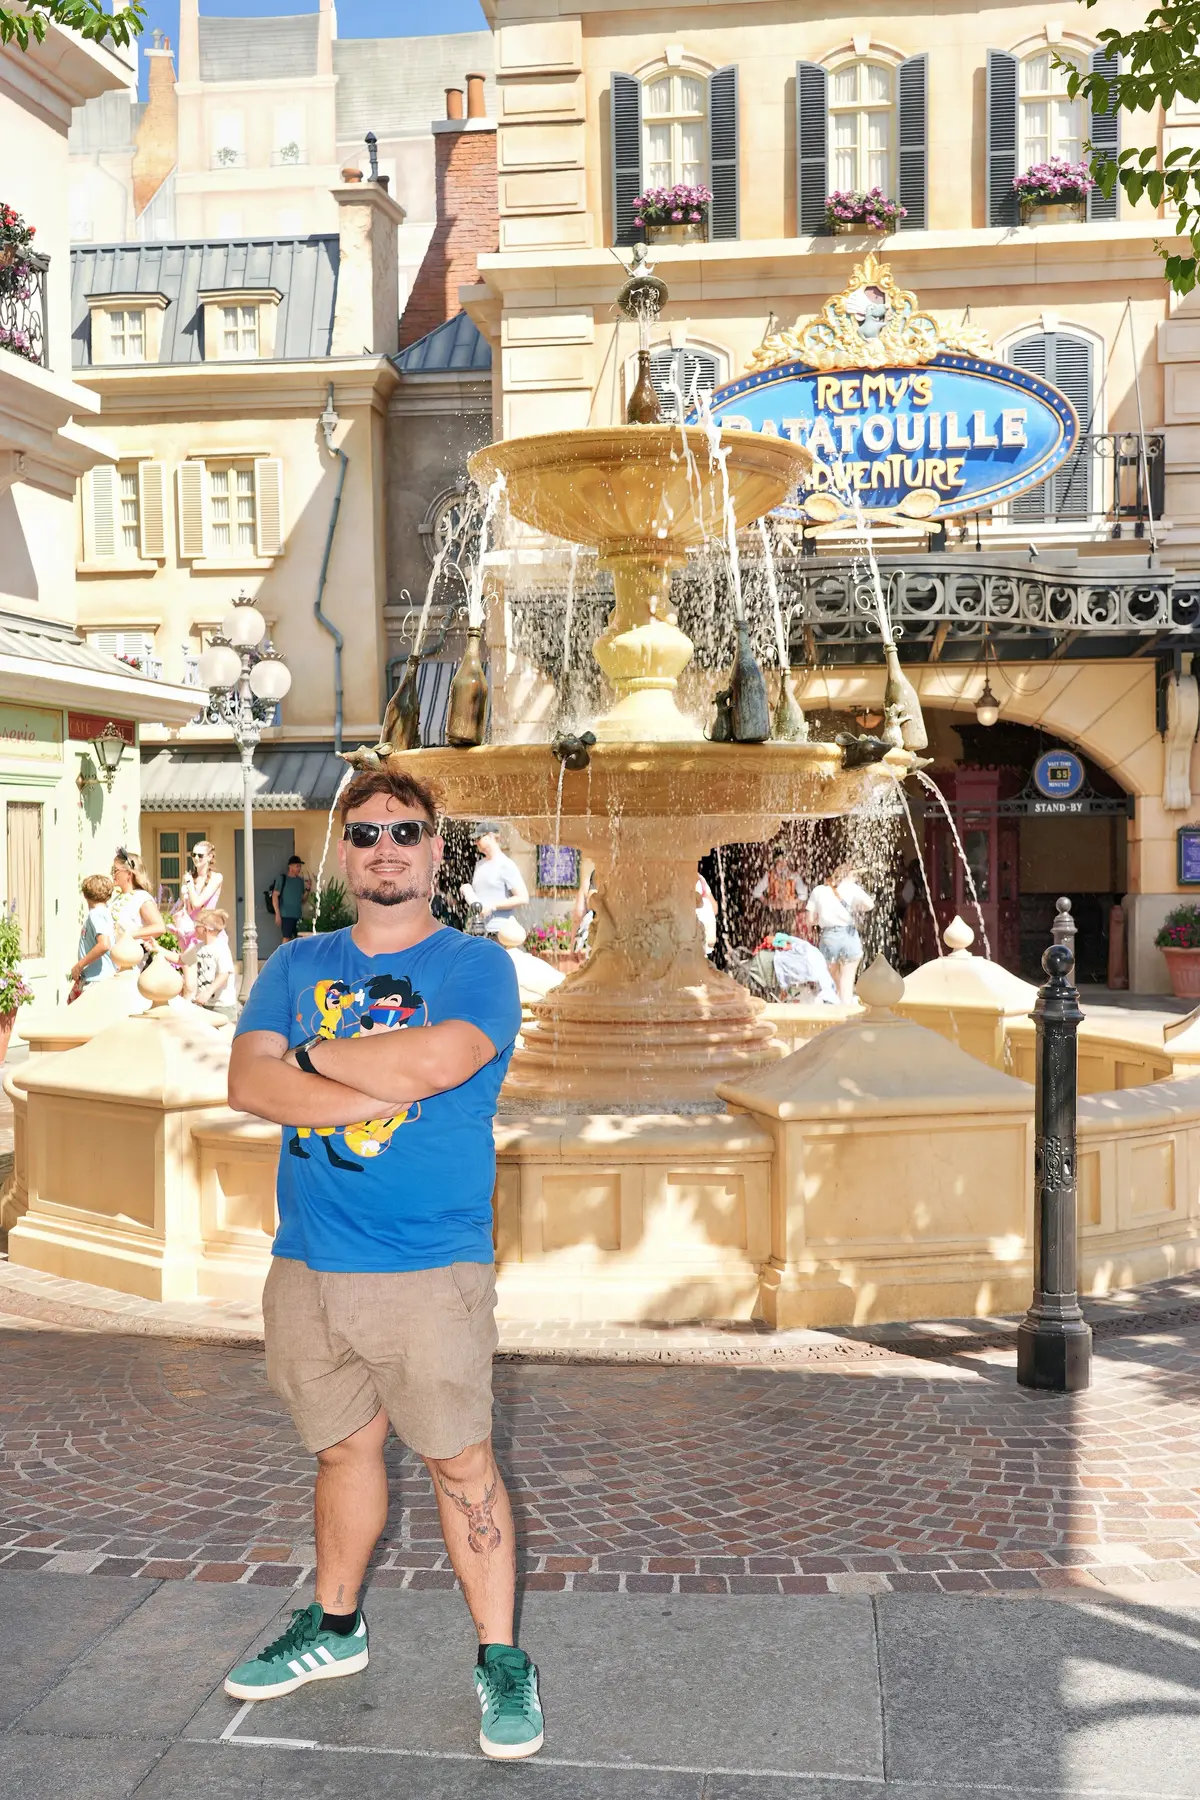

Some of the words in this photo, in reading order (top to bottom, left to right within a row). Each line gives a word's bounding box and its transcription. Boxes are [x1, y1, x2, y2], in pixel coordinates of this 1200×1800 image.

[817, 373, 934, 413] REMY'S
[1056, 769, 1068, 779] 55
[1034, 802, 1083, 812] STAND-BY
